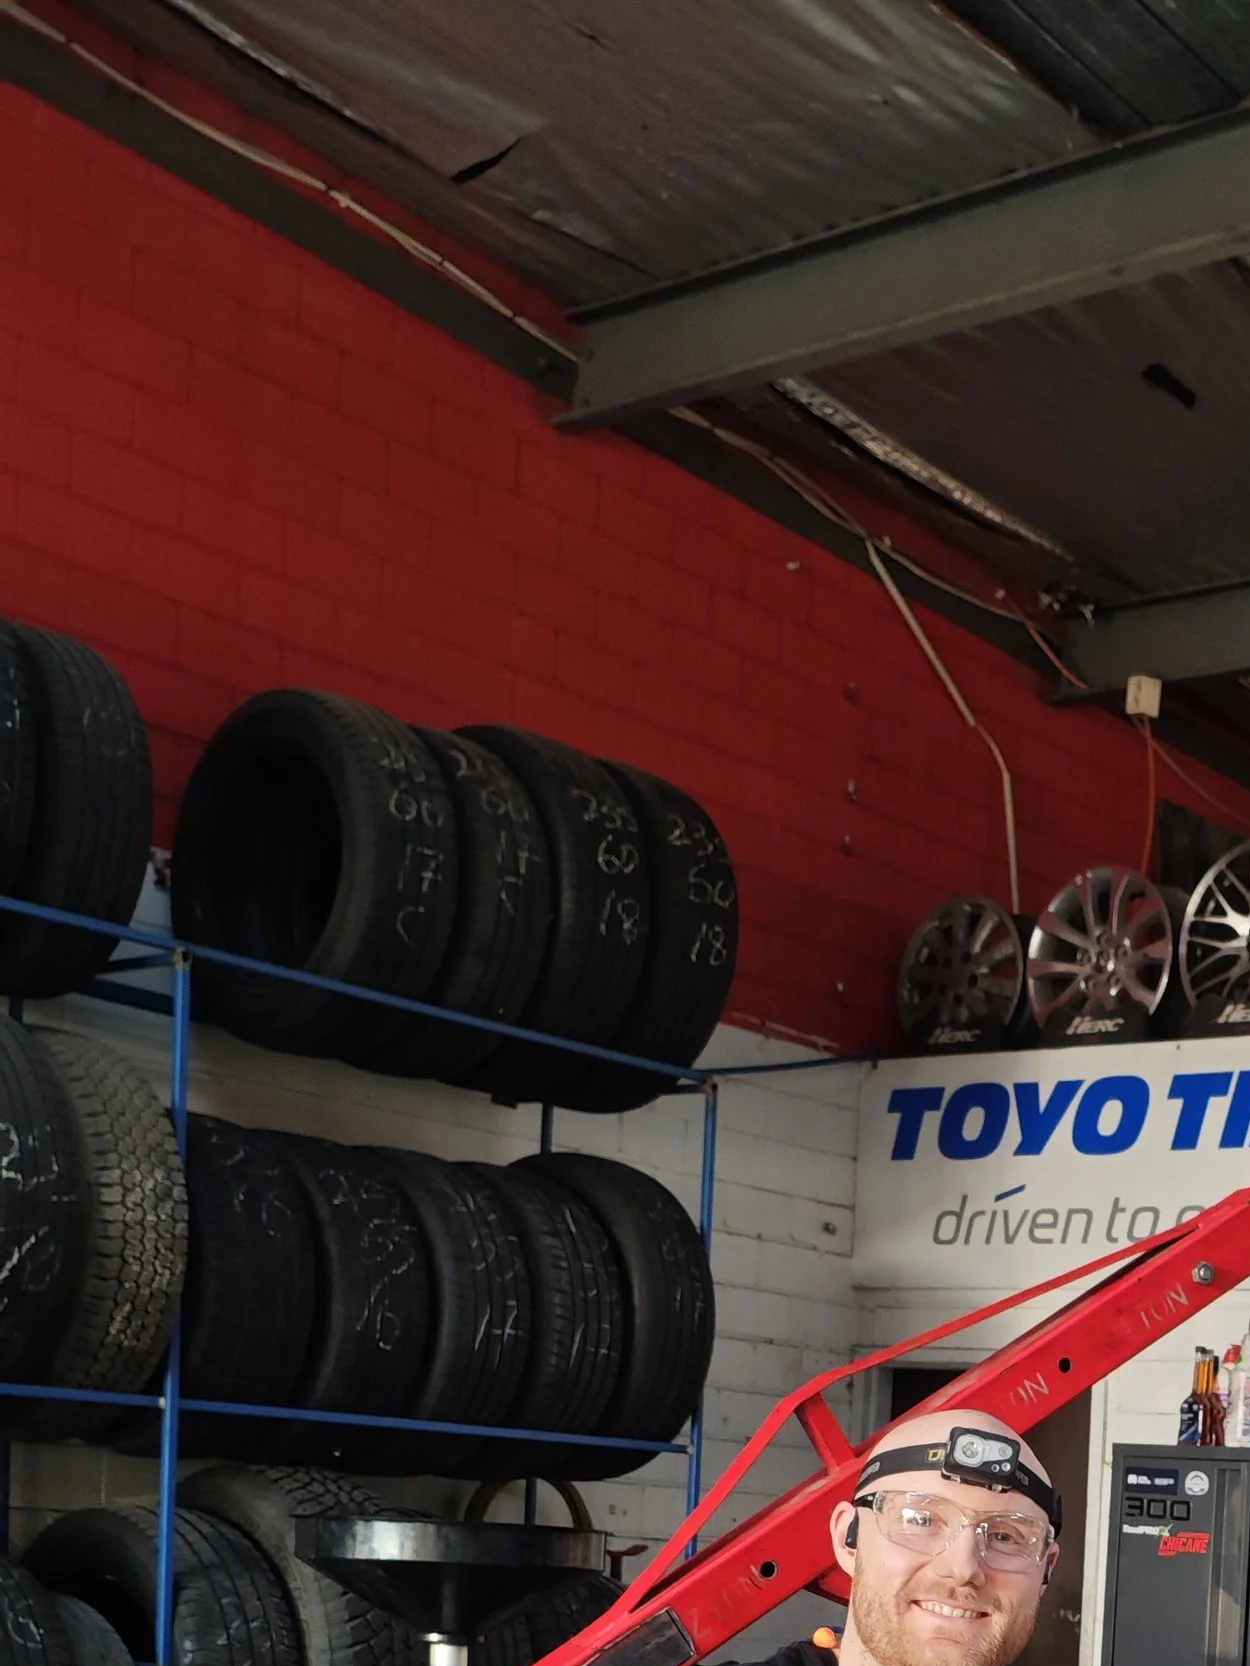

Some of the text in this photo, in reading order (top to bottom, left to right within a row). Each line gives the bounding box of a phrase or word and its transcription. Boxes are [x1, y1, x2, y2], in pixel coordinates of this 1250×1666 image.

[597, 833, 640, 874] 60
[690, 921, 727, 966] 18
[887, 1074, 1151, 1161] TOYO
[1125, 1497, 1190, 1521] 300
